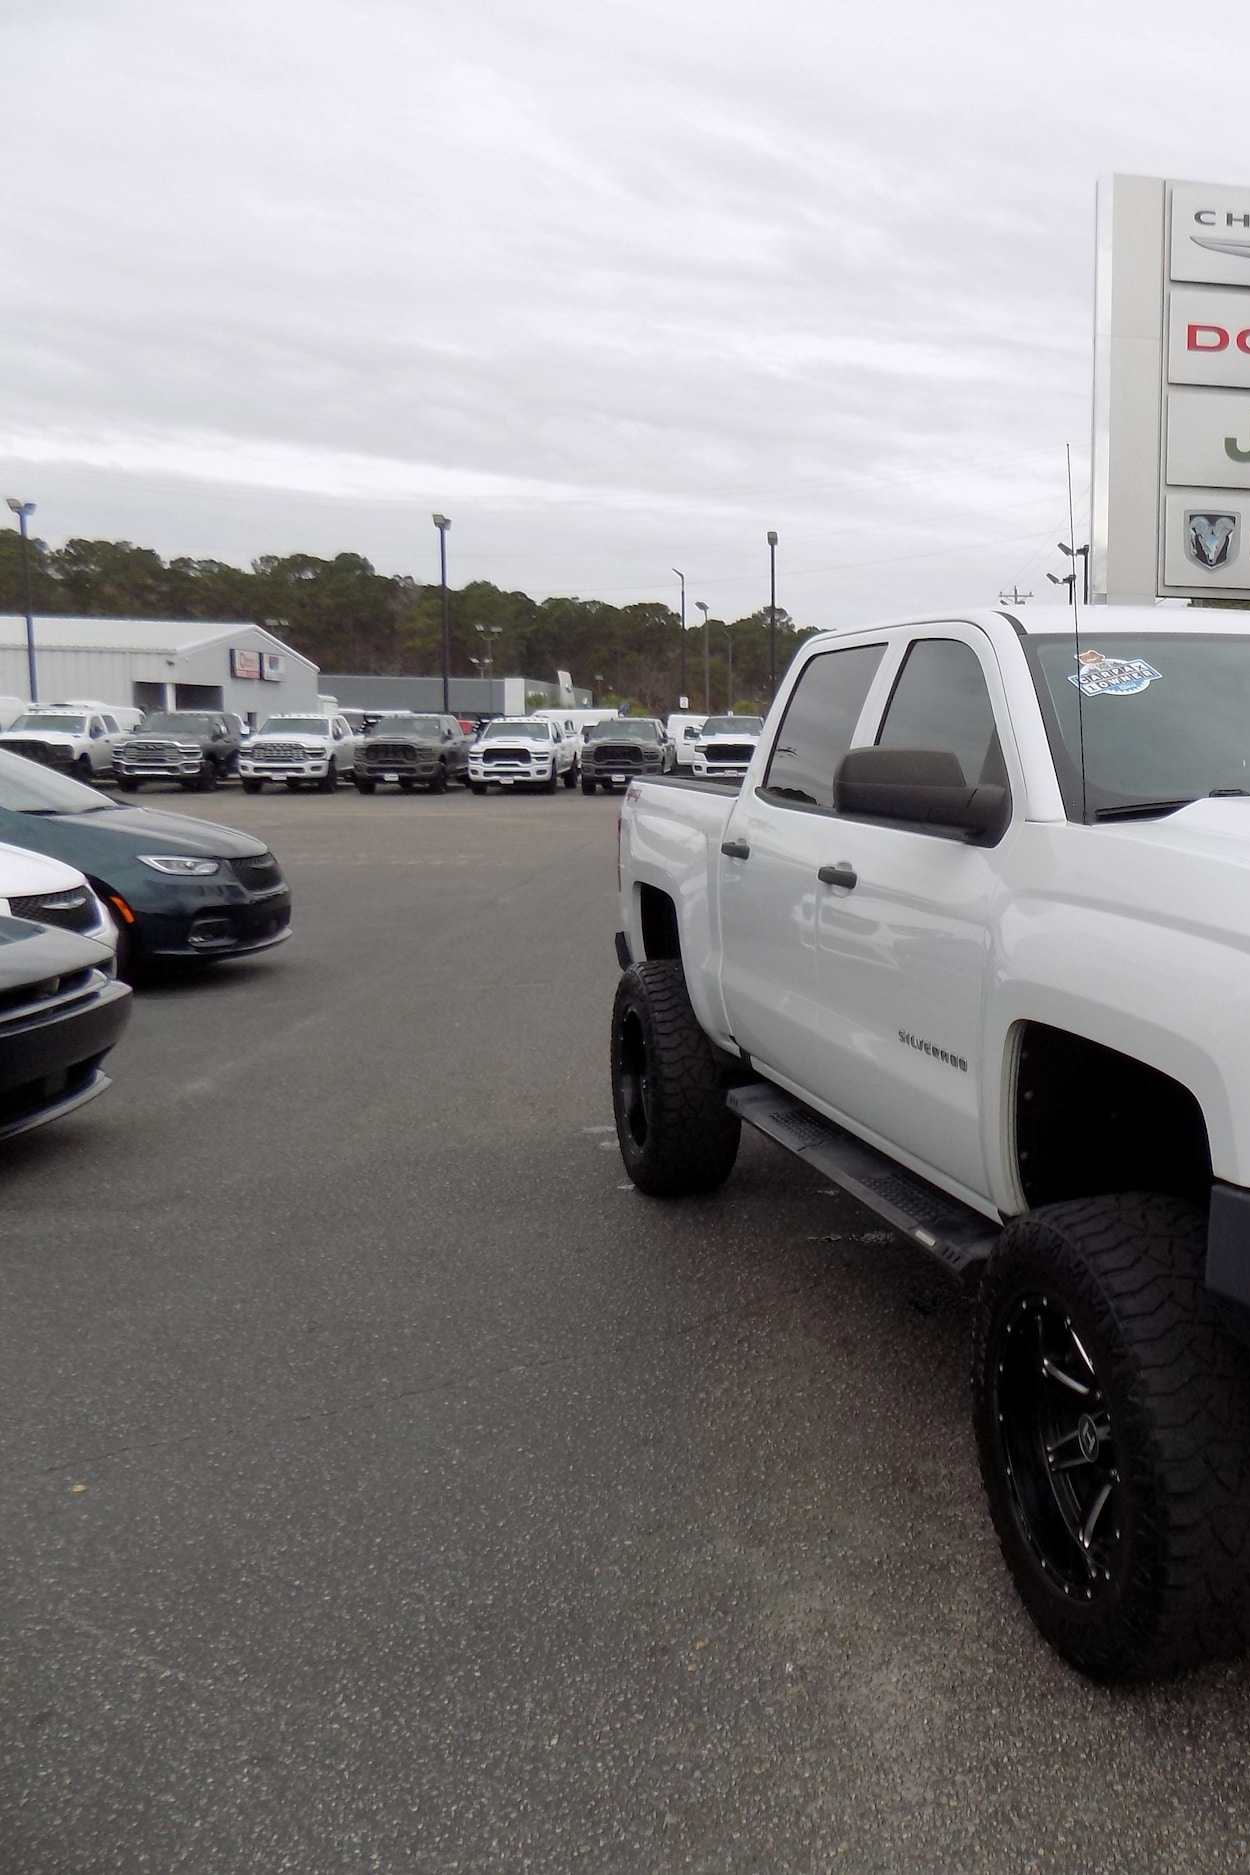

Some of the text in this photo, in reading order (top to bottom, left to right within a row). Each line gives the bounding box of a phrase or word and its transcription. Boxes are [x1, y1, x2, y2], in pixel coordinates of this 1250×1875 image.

[1080, 664, 1146, 684] CARFAX
[1098, 670, 1153, 689] OWNER
[898, 1029, 968, 1072] SILVERADO
